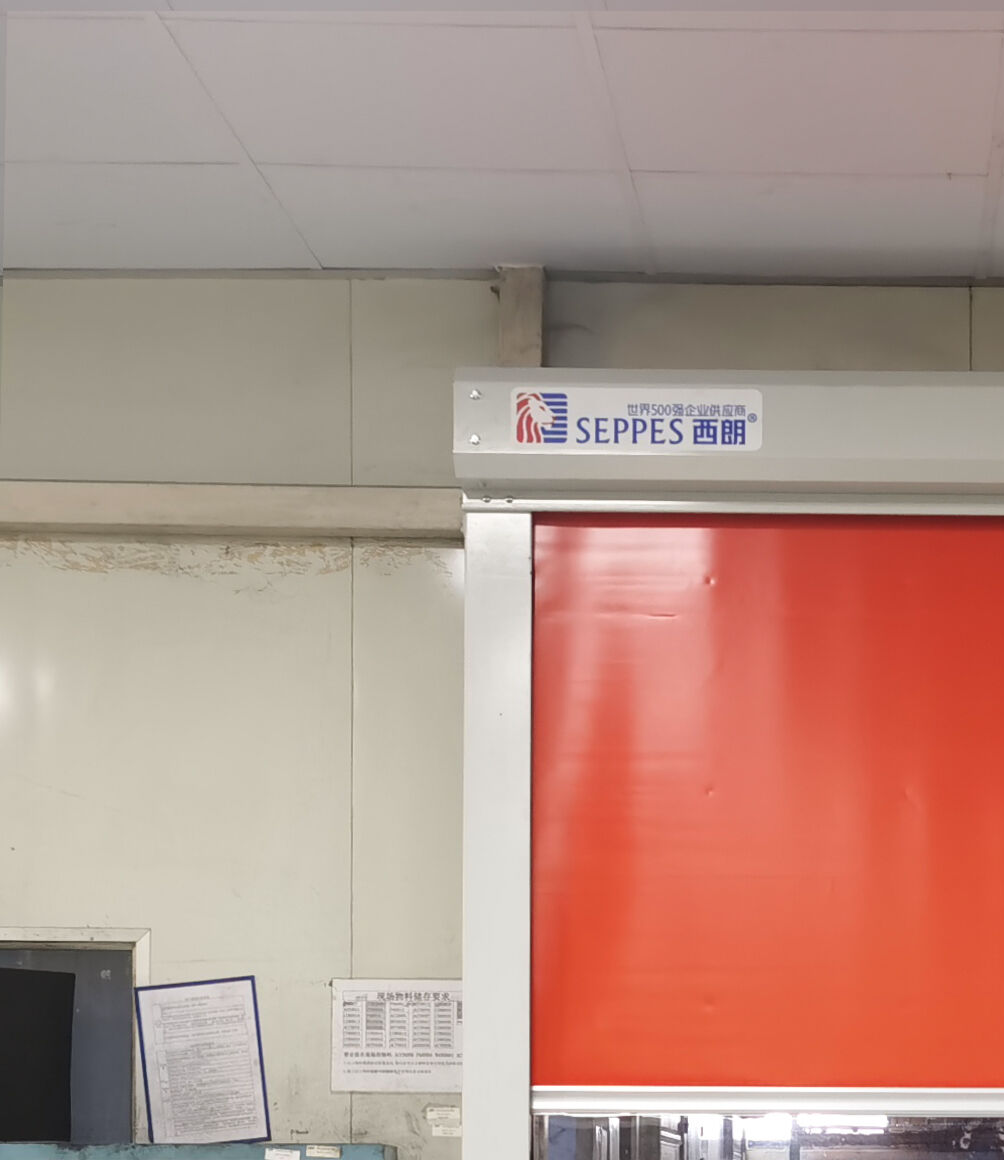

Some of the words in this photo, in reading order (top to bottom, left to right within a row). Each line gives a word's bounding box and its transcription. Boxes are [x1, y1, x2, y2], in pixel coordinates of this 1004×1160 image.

[627, 403, 746, 418] 世界500强企业供应商
[576, 417, 683, 445] SEPPES
